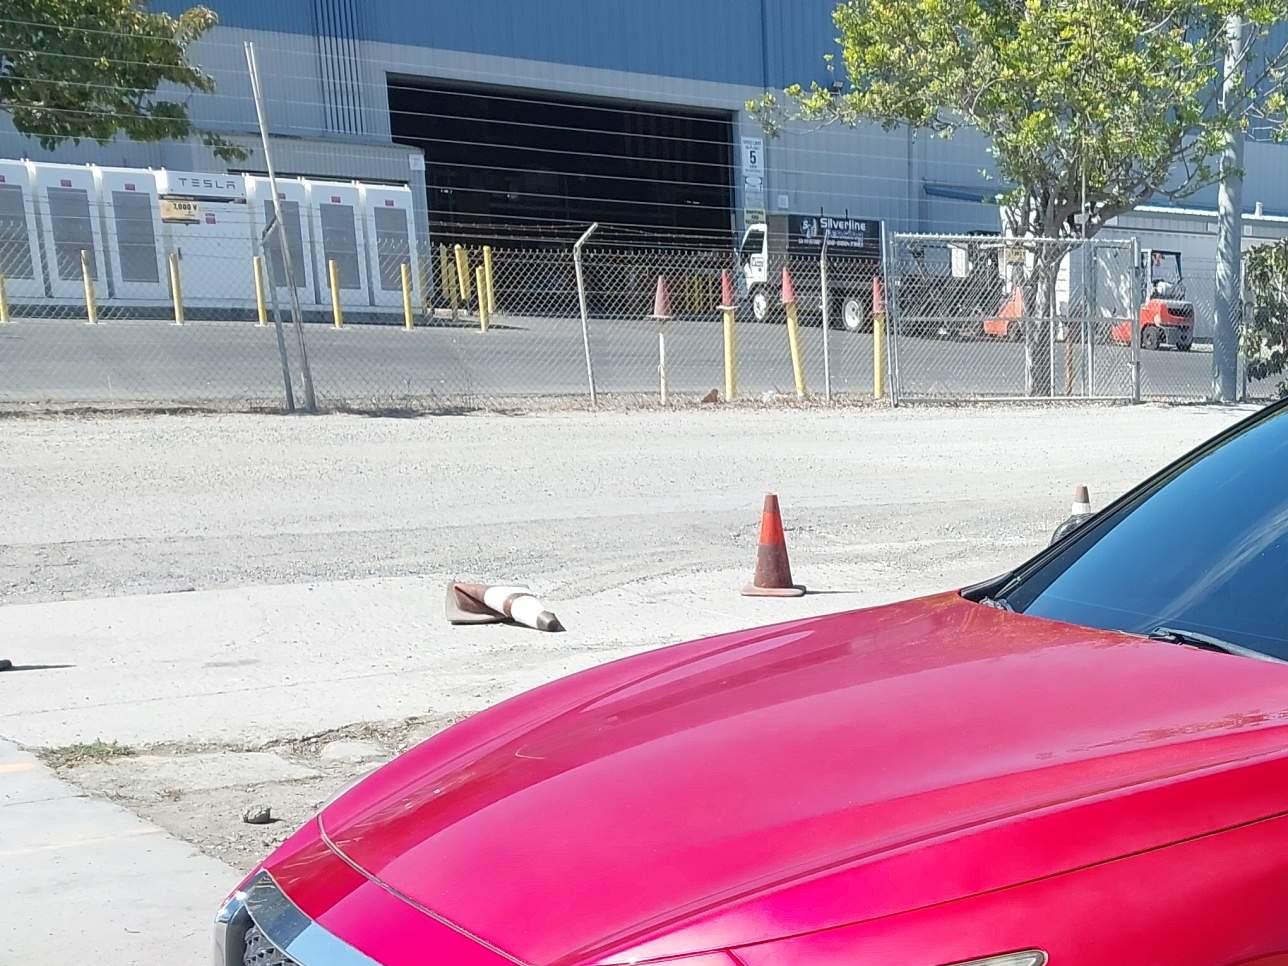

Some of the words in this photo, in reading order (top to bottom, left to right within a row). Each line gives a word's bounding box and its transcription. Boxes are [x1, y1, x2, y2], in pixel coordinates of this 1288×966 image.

[750, 150, 756, 164] 5
[178, 177, 236, 189] TESLA
[820, 217, 866, 232] Silverline
